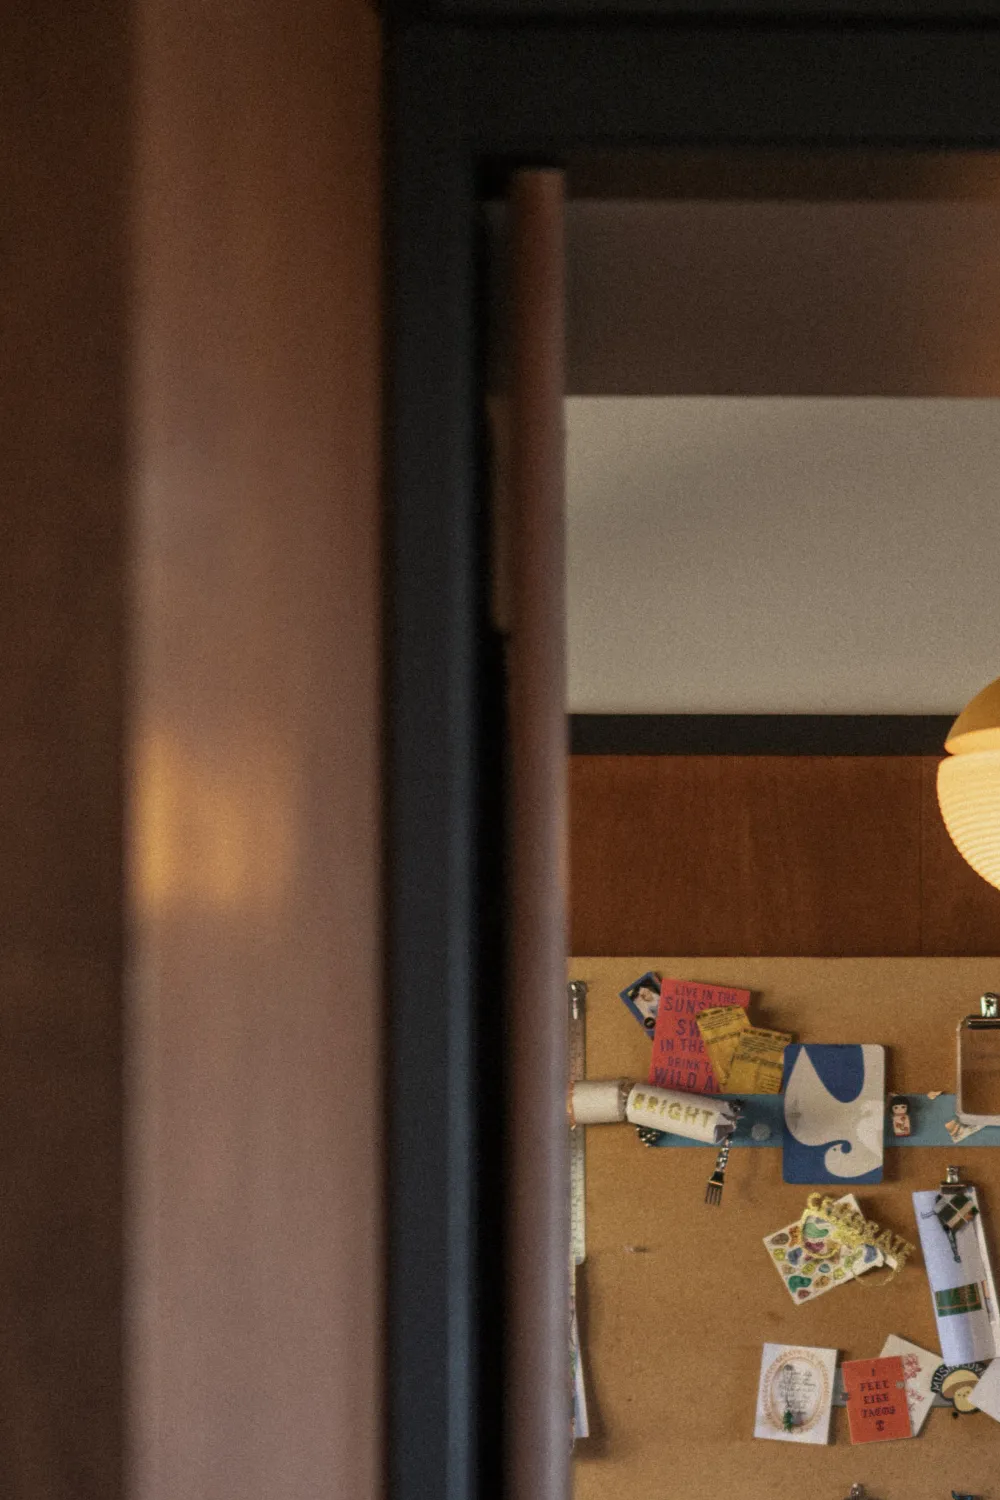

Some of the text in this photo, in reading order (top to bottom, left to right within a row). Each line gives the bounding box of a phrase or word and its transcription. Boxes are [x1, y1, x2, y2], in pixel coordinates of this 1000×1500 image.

[675, 985, 738, 1004] LIVE IN THE
[659, 1038, 705, 1053] IN THE
[667, 1056, 700, 1070] DRINK
[654, 1067, 697, 1088] WILD
[633, 1093, 714, 1128] BRIGHT
[859, 1380, 890, 1392] FEEL
[863, 1392, 889, 1405] LIKE
[860, 1405, 896, 1419] TACOS
